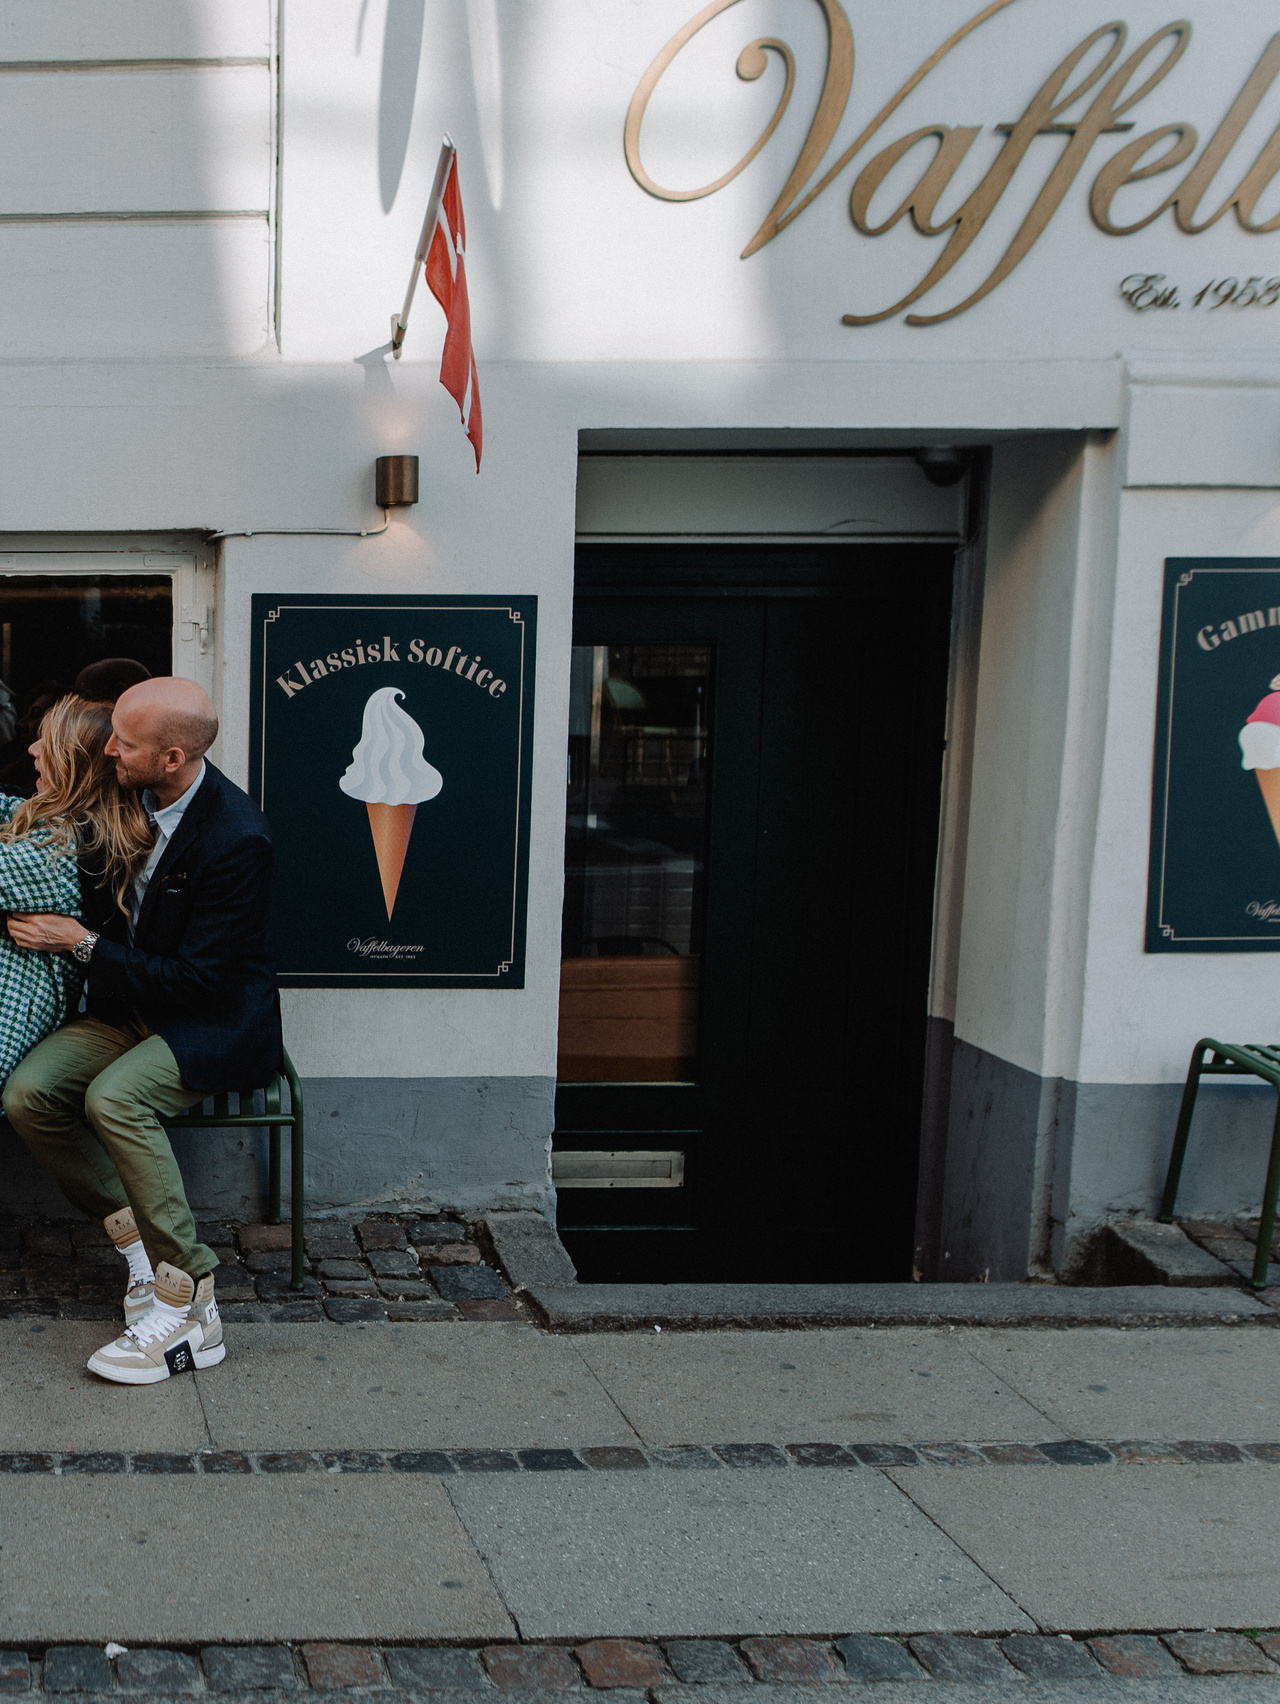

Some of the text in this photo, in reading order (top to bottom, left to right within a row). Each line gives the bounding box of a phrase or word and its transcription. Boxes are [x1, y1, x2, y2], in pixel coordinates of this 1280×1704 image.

[275, 636, 507, 699] Klassisk Softice
[346, 936, 425, 957] Vaffelbageren
